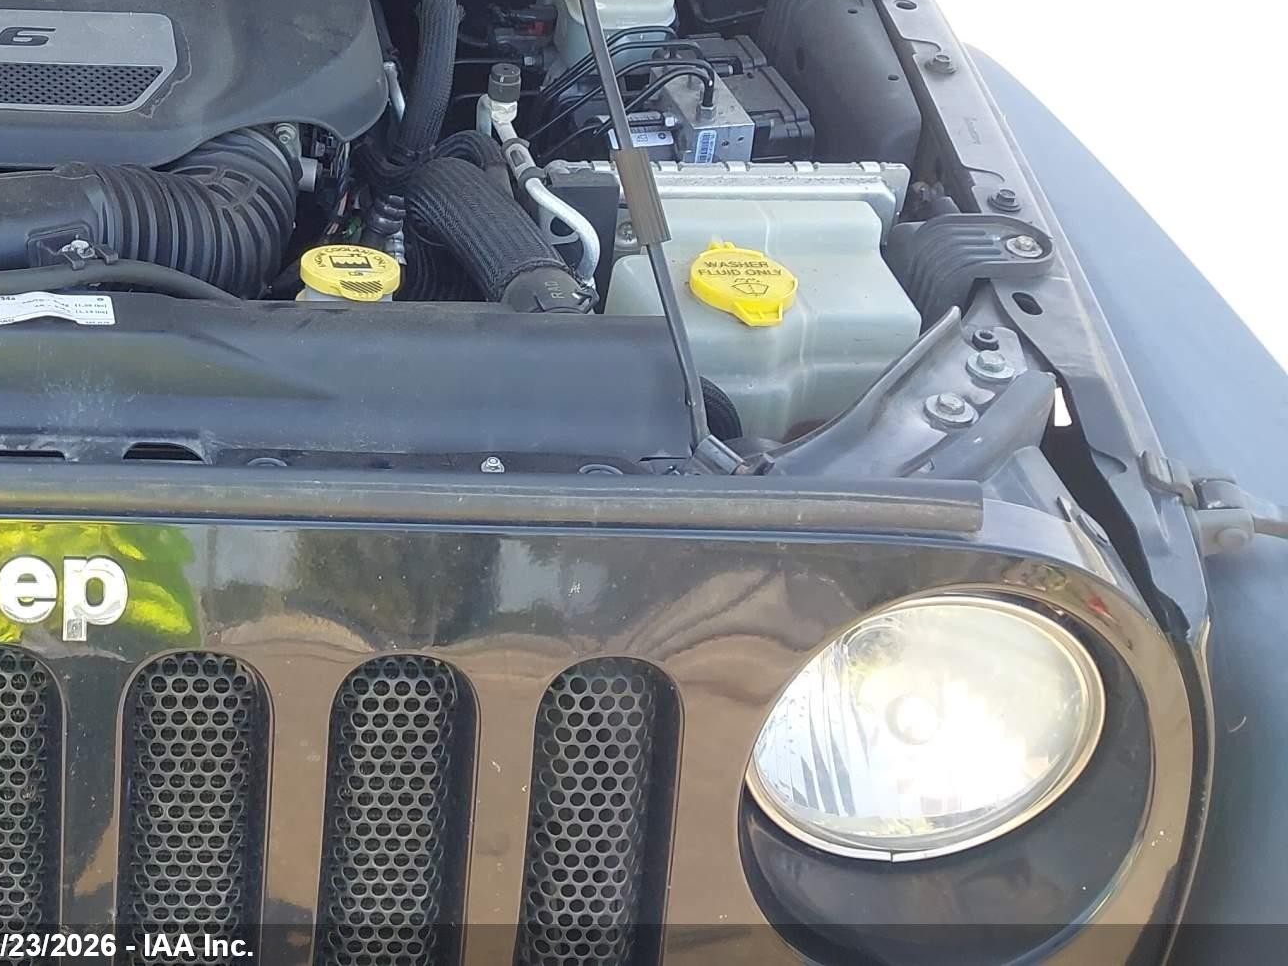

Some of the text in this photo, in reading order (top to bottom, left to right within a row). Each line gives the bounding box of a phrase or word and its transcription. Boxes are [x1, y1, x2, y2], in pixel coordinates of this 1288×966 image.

[324, 247, 375, 258] COOLANT
[704, 260, 769, 268] WASHER
[698, 268, 782, 276] FLUID ONLY
